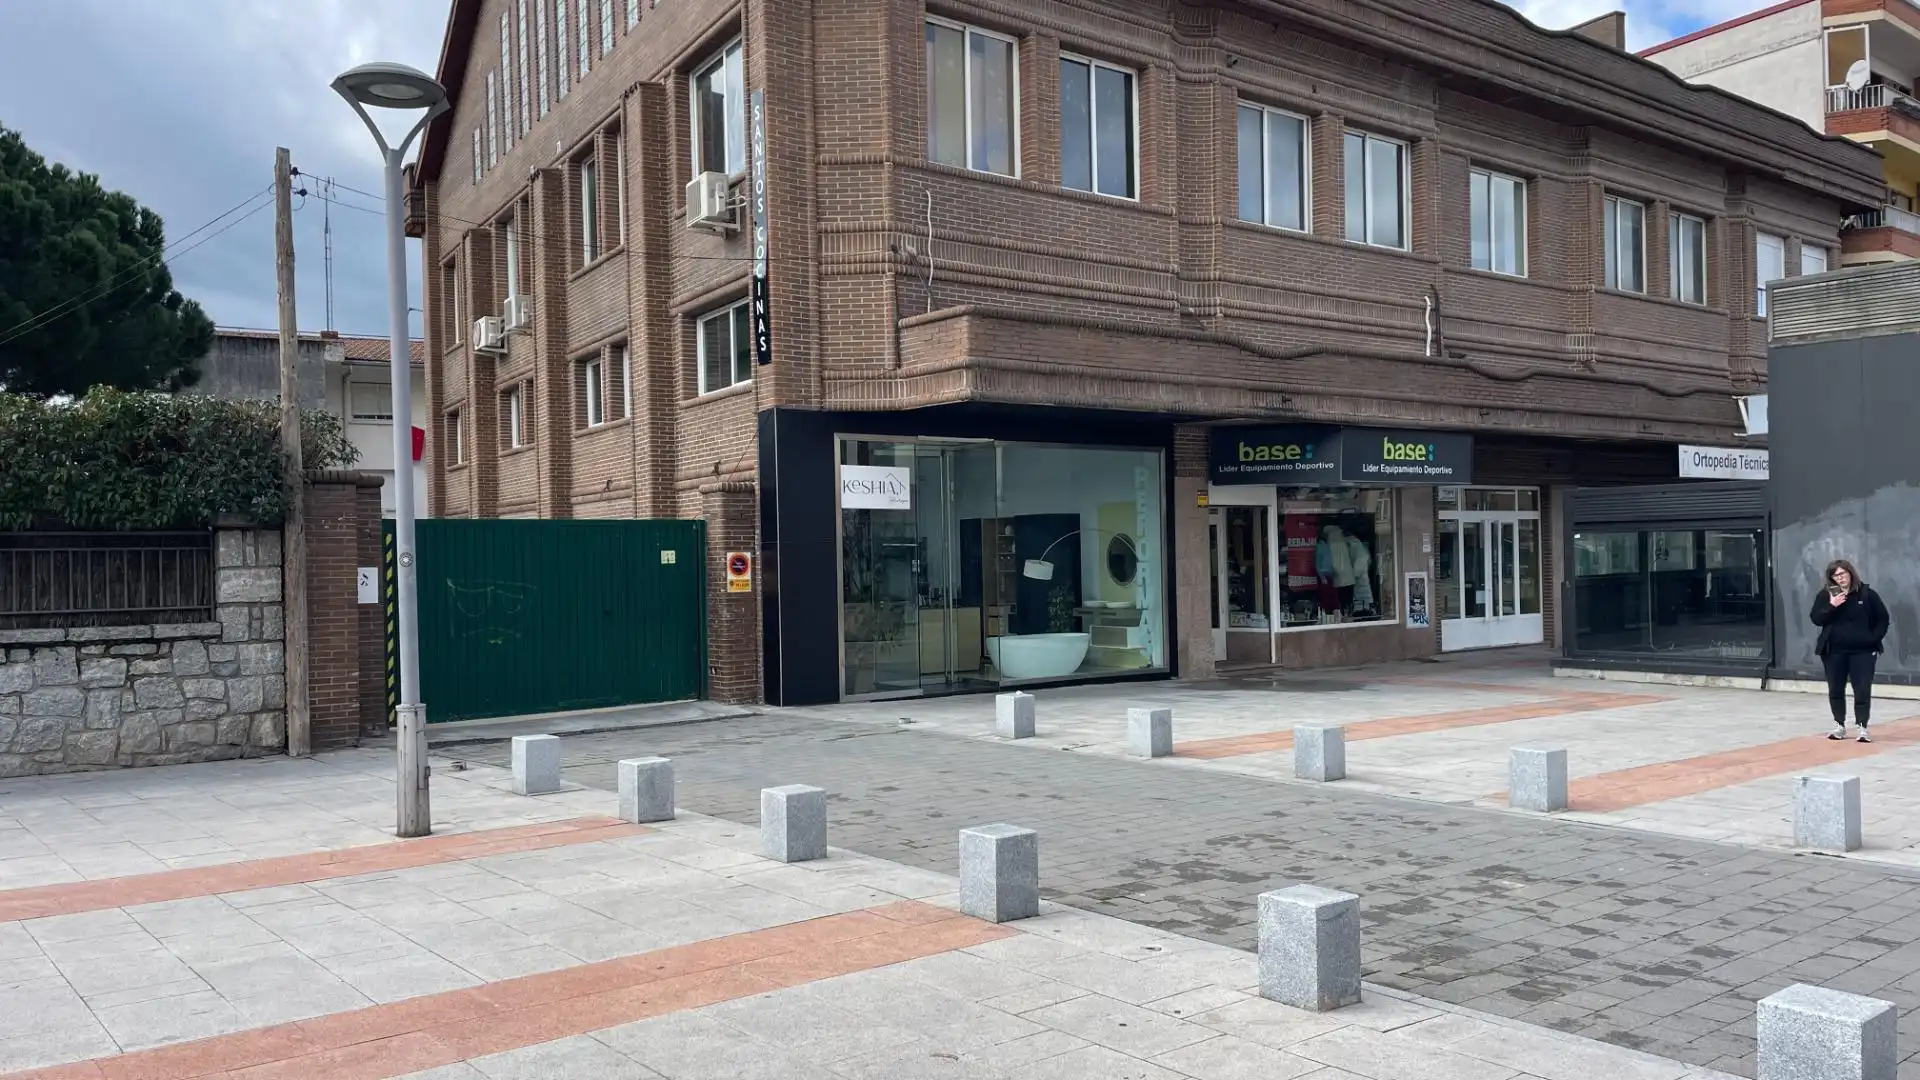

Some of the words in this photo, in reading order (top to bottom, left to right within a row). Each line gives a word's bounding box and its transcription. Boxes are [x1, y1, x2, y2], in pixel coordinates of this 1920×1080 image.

[754, 105, 765, 213] SANTOS
[755, 226, 767, 351] COCINAS
[1240, 463, 1293, 473] Equipamiento
[1295, 461, 1334, 471] Deportivo
[1380, 464, 1422, 474] Equipamiento
[1424, 465, 1452, 475] Deportivo
[1693, 452, 1737, 471] Ortopedia
[1739, 455, 1769, 470] Técnica
